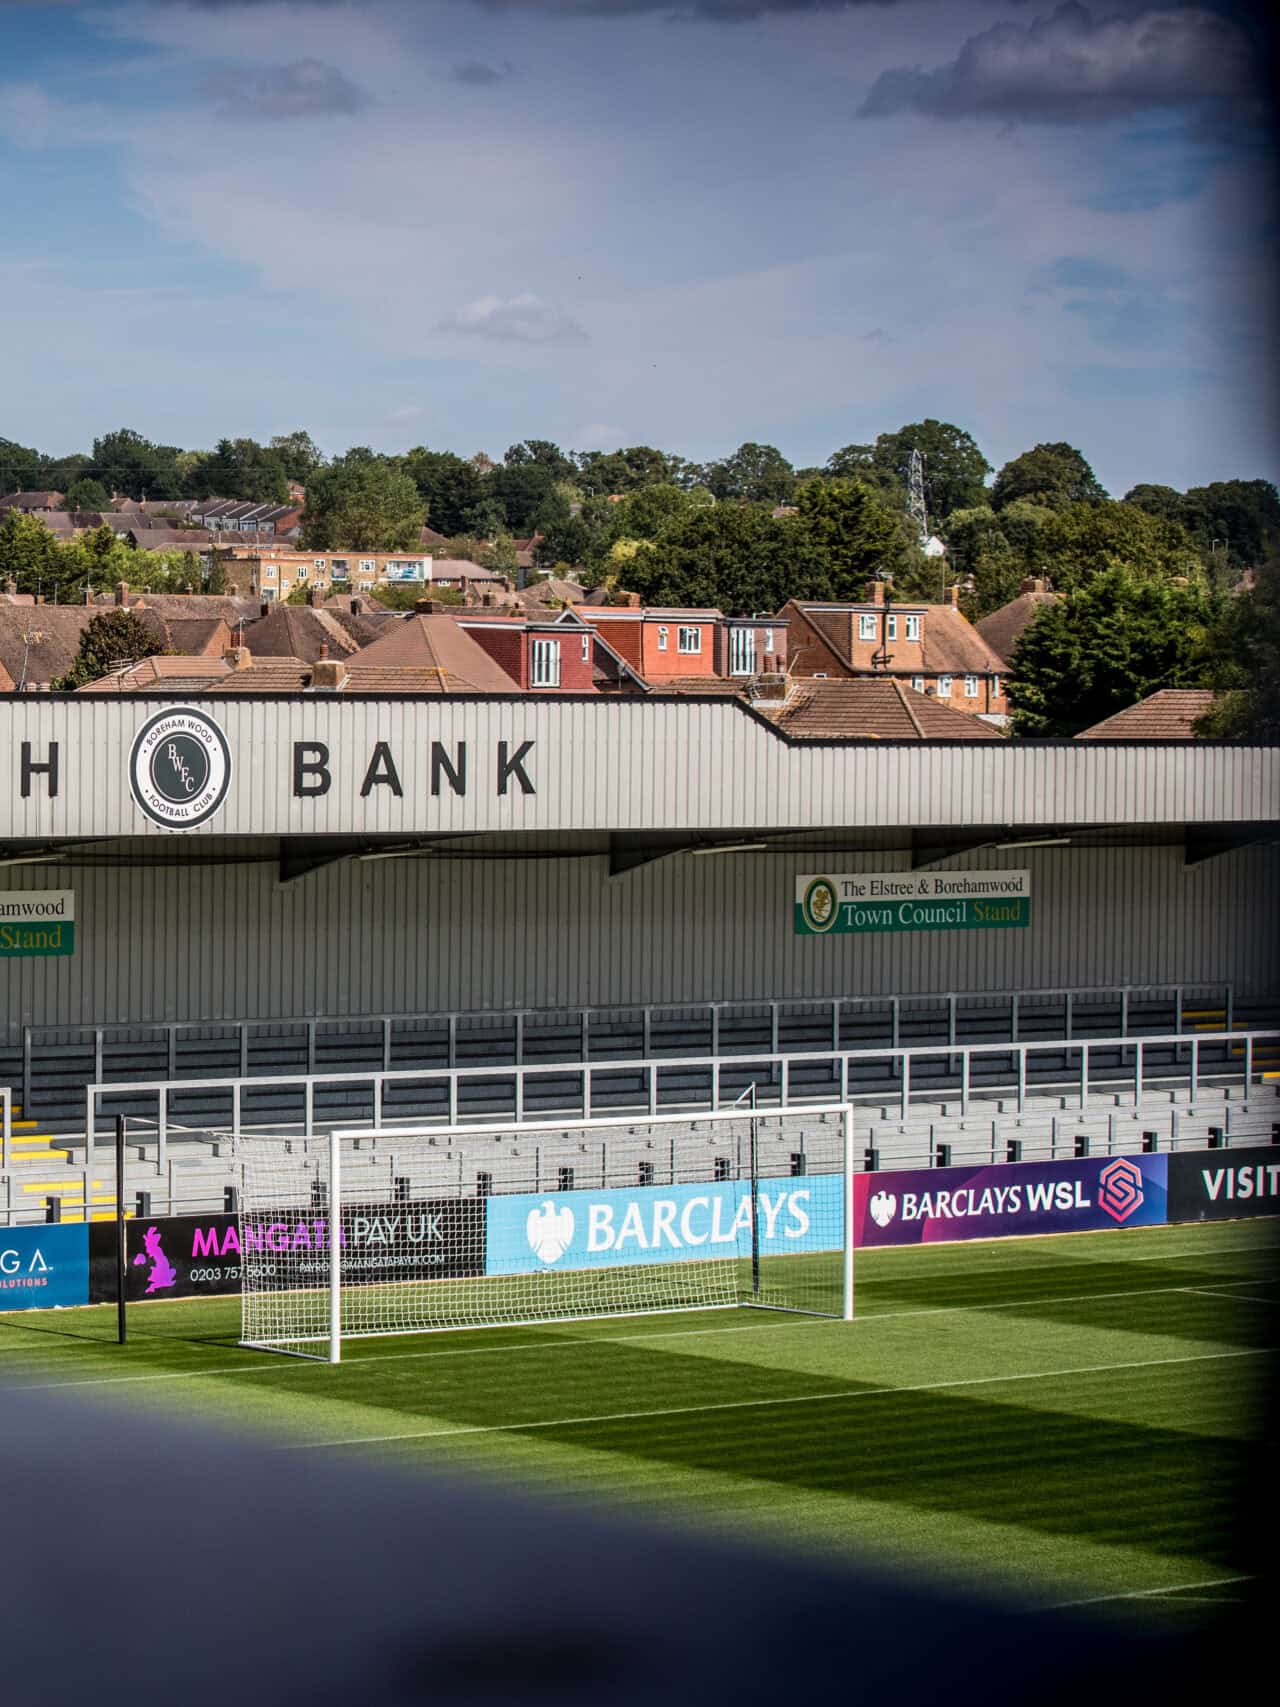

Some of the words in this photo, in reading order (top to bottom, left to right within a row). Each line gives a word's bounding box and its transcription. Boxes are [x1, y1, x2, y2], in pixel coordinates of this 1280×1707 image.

[146, 719, 185, 746] BOREHAM
[187, 719, 213, 744] WOOD
[293, 740, 537, 798] BANK
[148, 794, 189, 817] FOOTBALL
[193, 792, 213, 813] CLUB
[841, 880, 866, 897] The
[870, 880, 914, 896] Elstree
[918, 879, 930, 895] &
[935, 876, 1024, 895] Borehamwood
[843, 905, 893, 927] Town
[898, 901, 967, 926] Council
[974, 901, 1021, 921] Stand
[0, 924, 63, 950] Stand
[1200, 1164, 1280, 1201] VISIT
[901, 1186, 1022, 1221] BARCLAYS
[1025, 1180, 1091, 1212] WSL
[353, 1215, 401, 1247] PAY
[406, 1212, 444, 1243] UK
[586, 1190, 811, 1252] BARCLAYS
[190, 1268, 221, 1282] 0203
